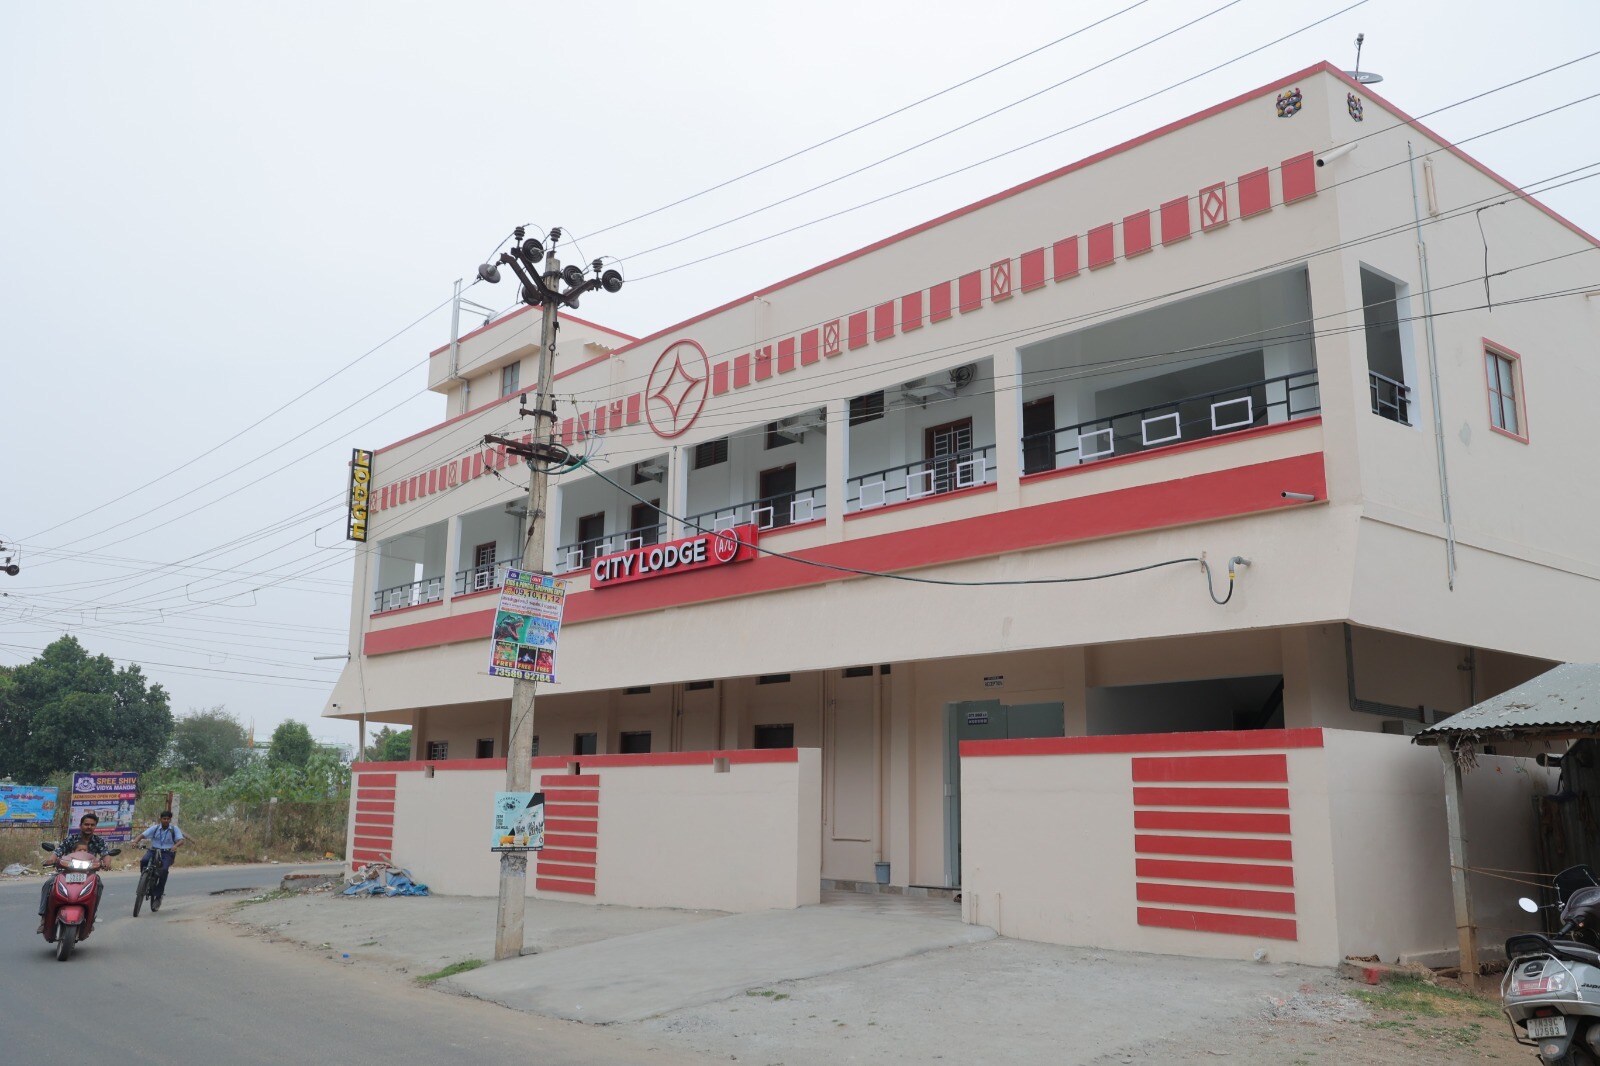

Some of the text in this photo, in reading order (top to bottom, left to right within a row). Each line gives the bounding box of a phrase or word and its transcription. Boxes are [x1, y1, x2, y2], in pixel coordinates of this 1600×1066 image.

[353, 449, 370, 539] LODGE
[594, 553, 634, 581] CITY
[639, 538, 707, 573] LODGE
[718, 539, 734, 553] A/C
[496, 660, 513, 668] FREE
[494, 667, 523, 679] 73589
[96, 777, 117, 785] SREE
